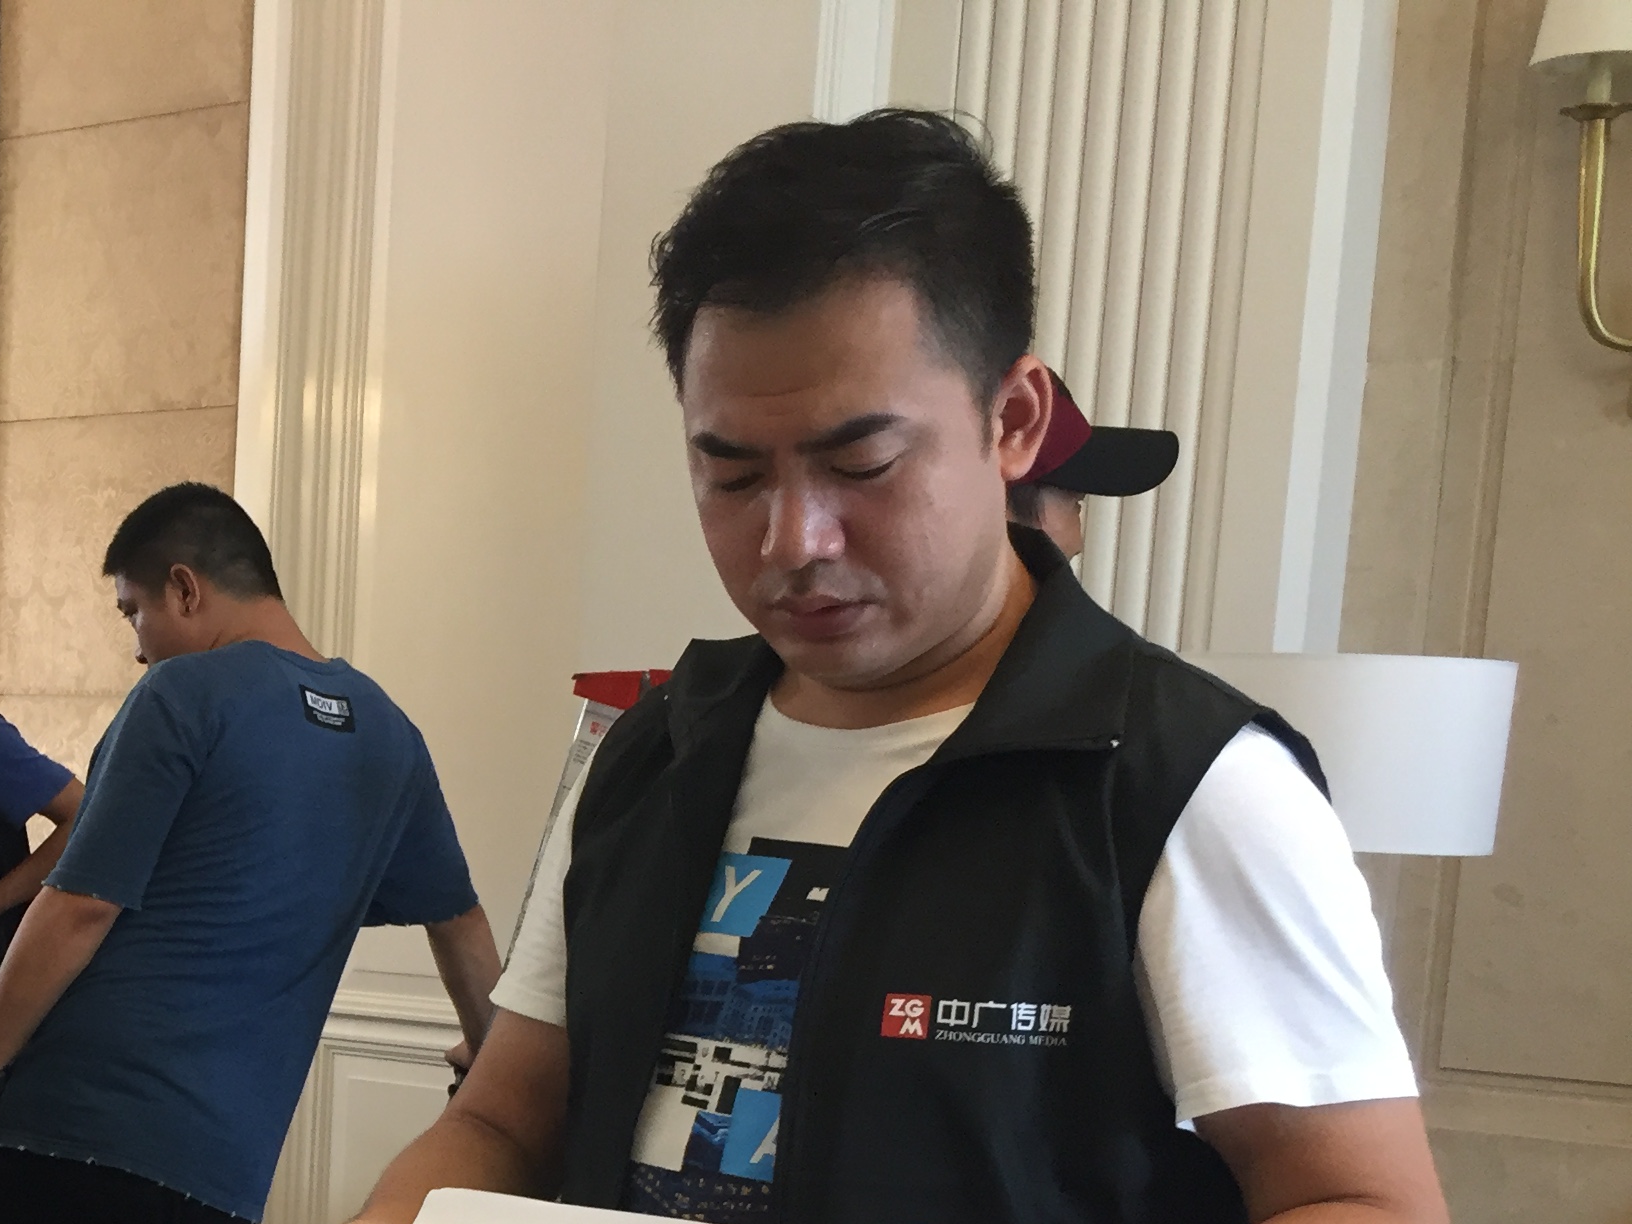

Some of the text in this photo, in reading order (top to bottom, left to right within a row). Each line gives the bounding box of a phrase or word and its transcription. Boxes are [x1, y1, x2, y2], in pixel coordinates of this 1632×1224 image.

[935, 999, 1072, 1033] 中广传媒
[934, 1029, 1068, 1047] ZHONGGUANG MEDIA
